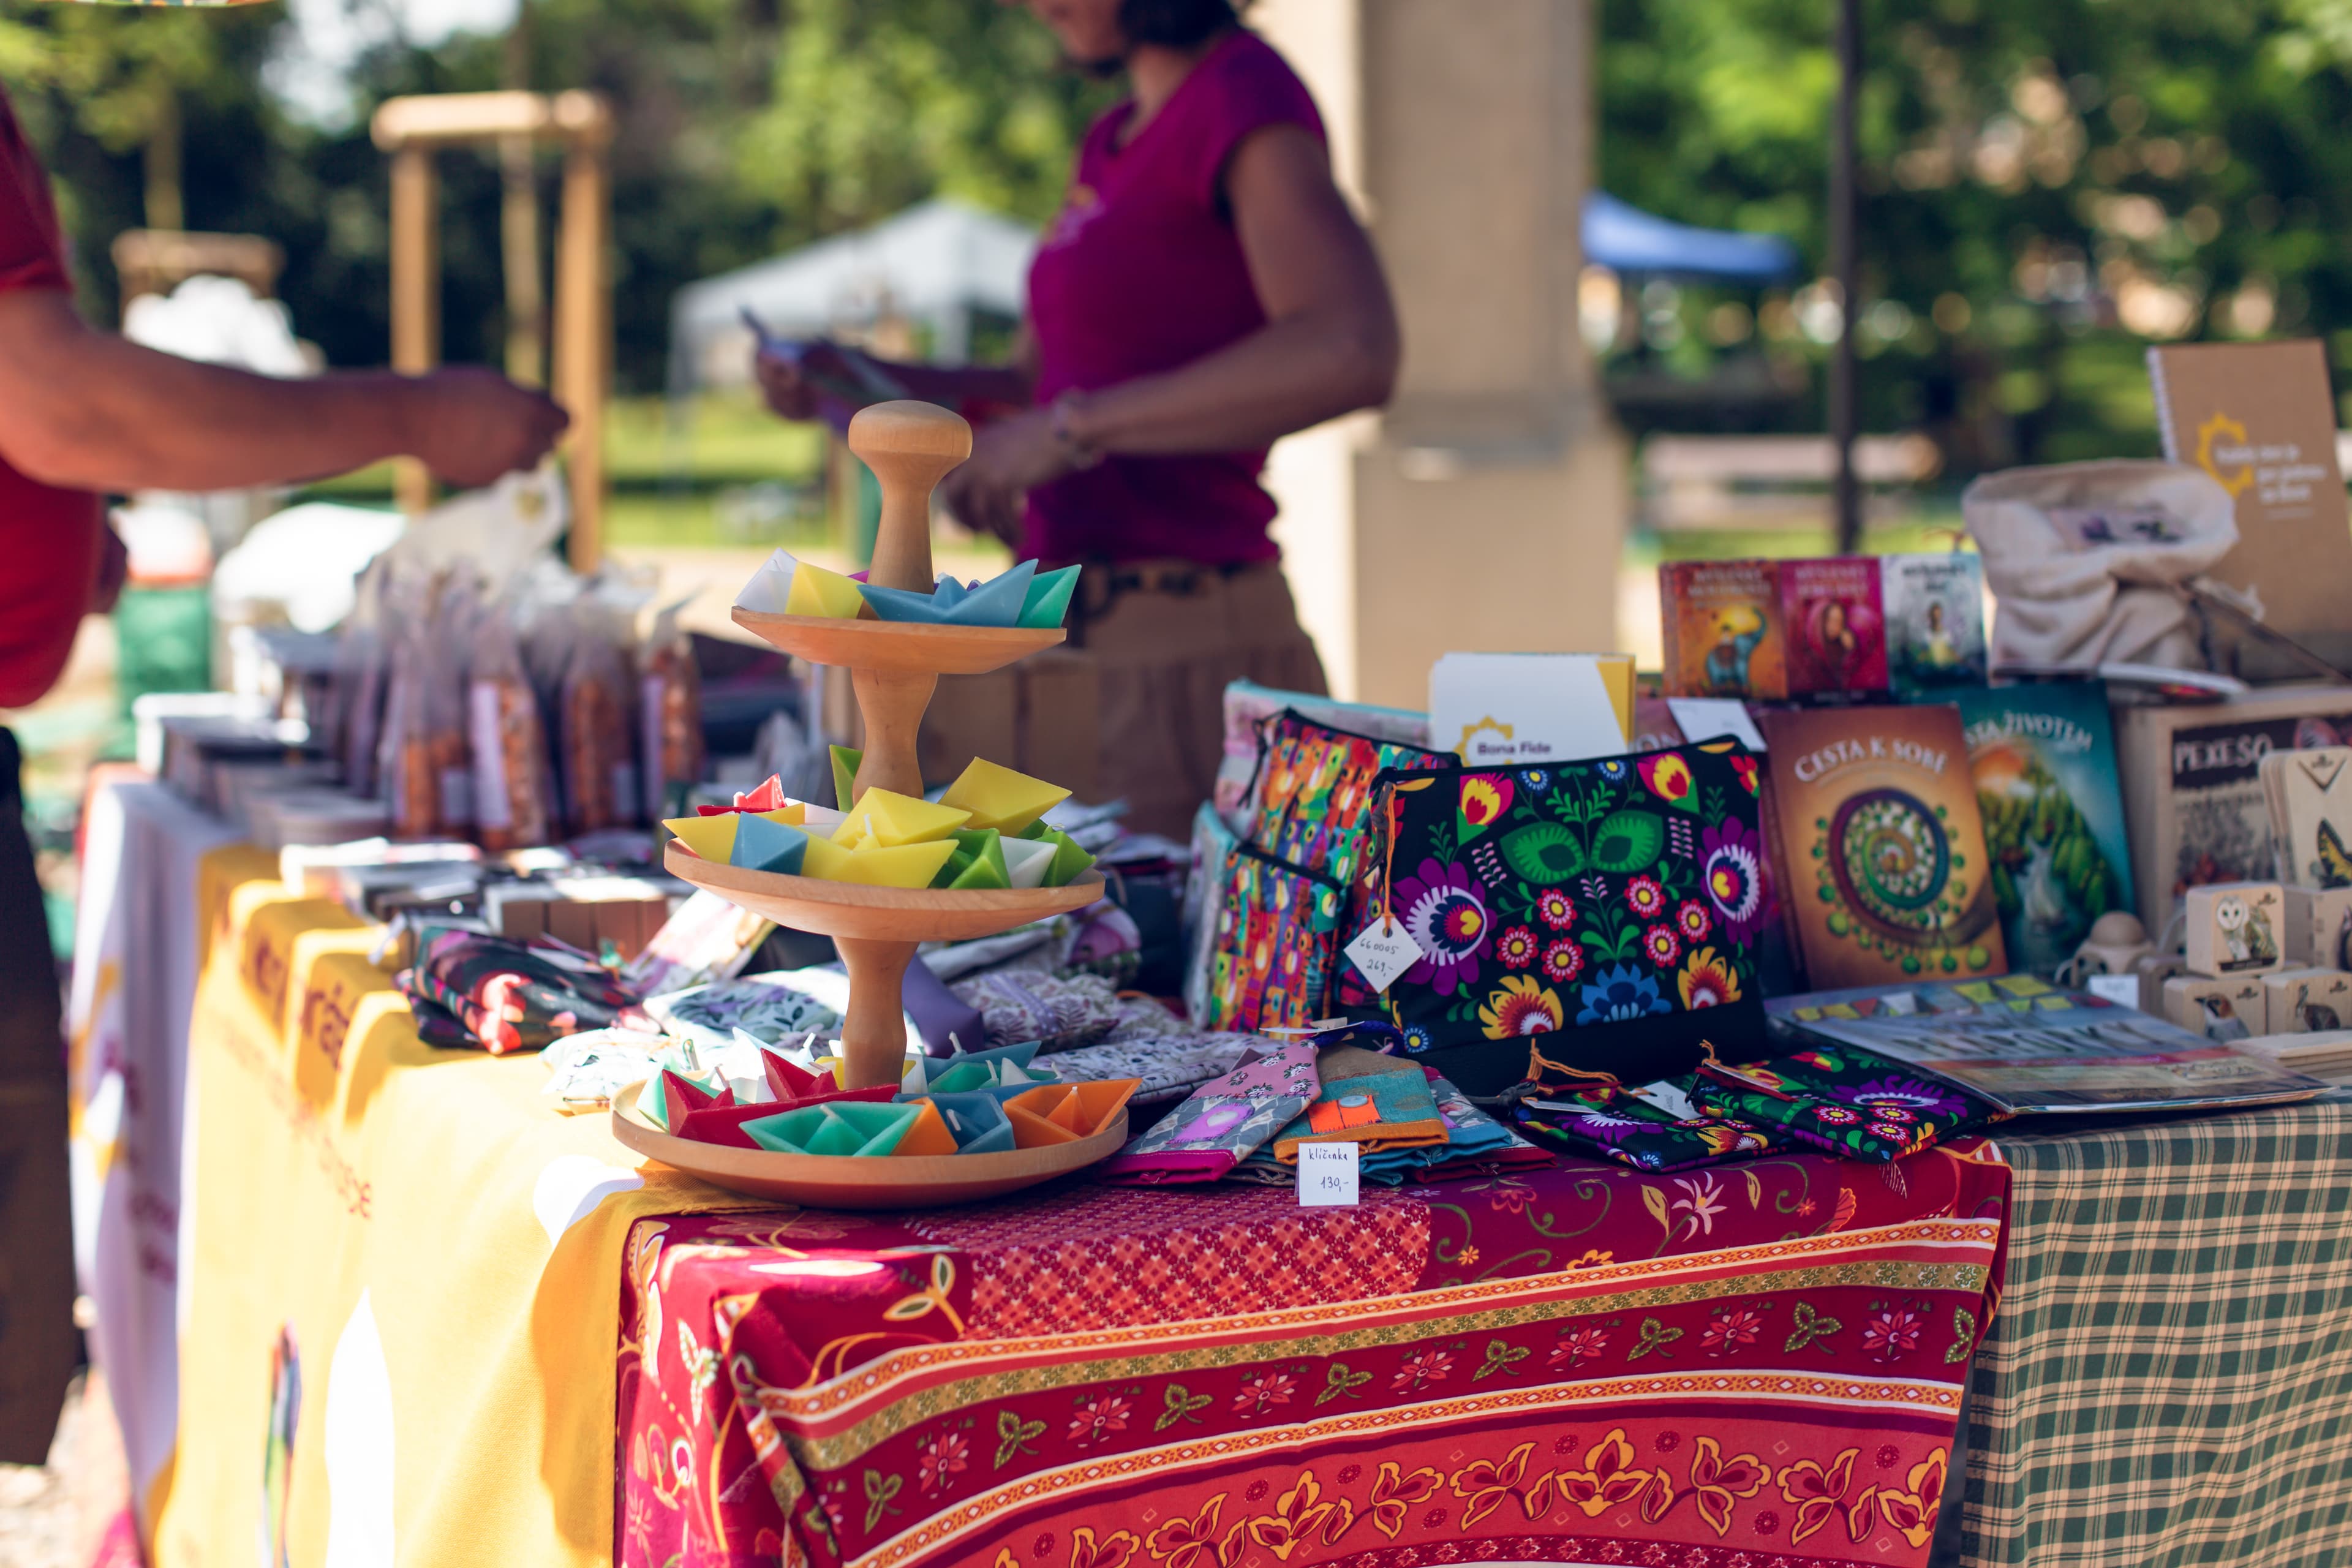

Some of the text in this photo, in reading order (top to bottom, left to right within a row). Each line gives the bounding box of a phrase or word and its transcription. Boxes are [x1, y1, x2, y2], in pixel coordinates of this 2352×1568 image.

[1478, 741, 1551, 755] Bona Fide
[1794, 738, 1866, 782] CESTA
[1870, 736, 1887, 758] K
[2175, 734, 2274, 774] PEXESO
